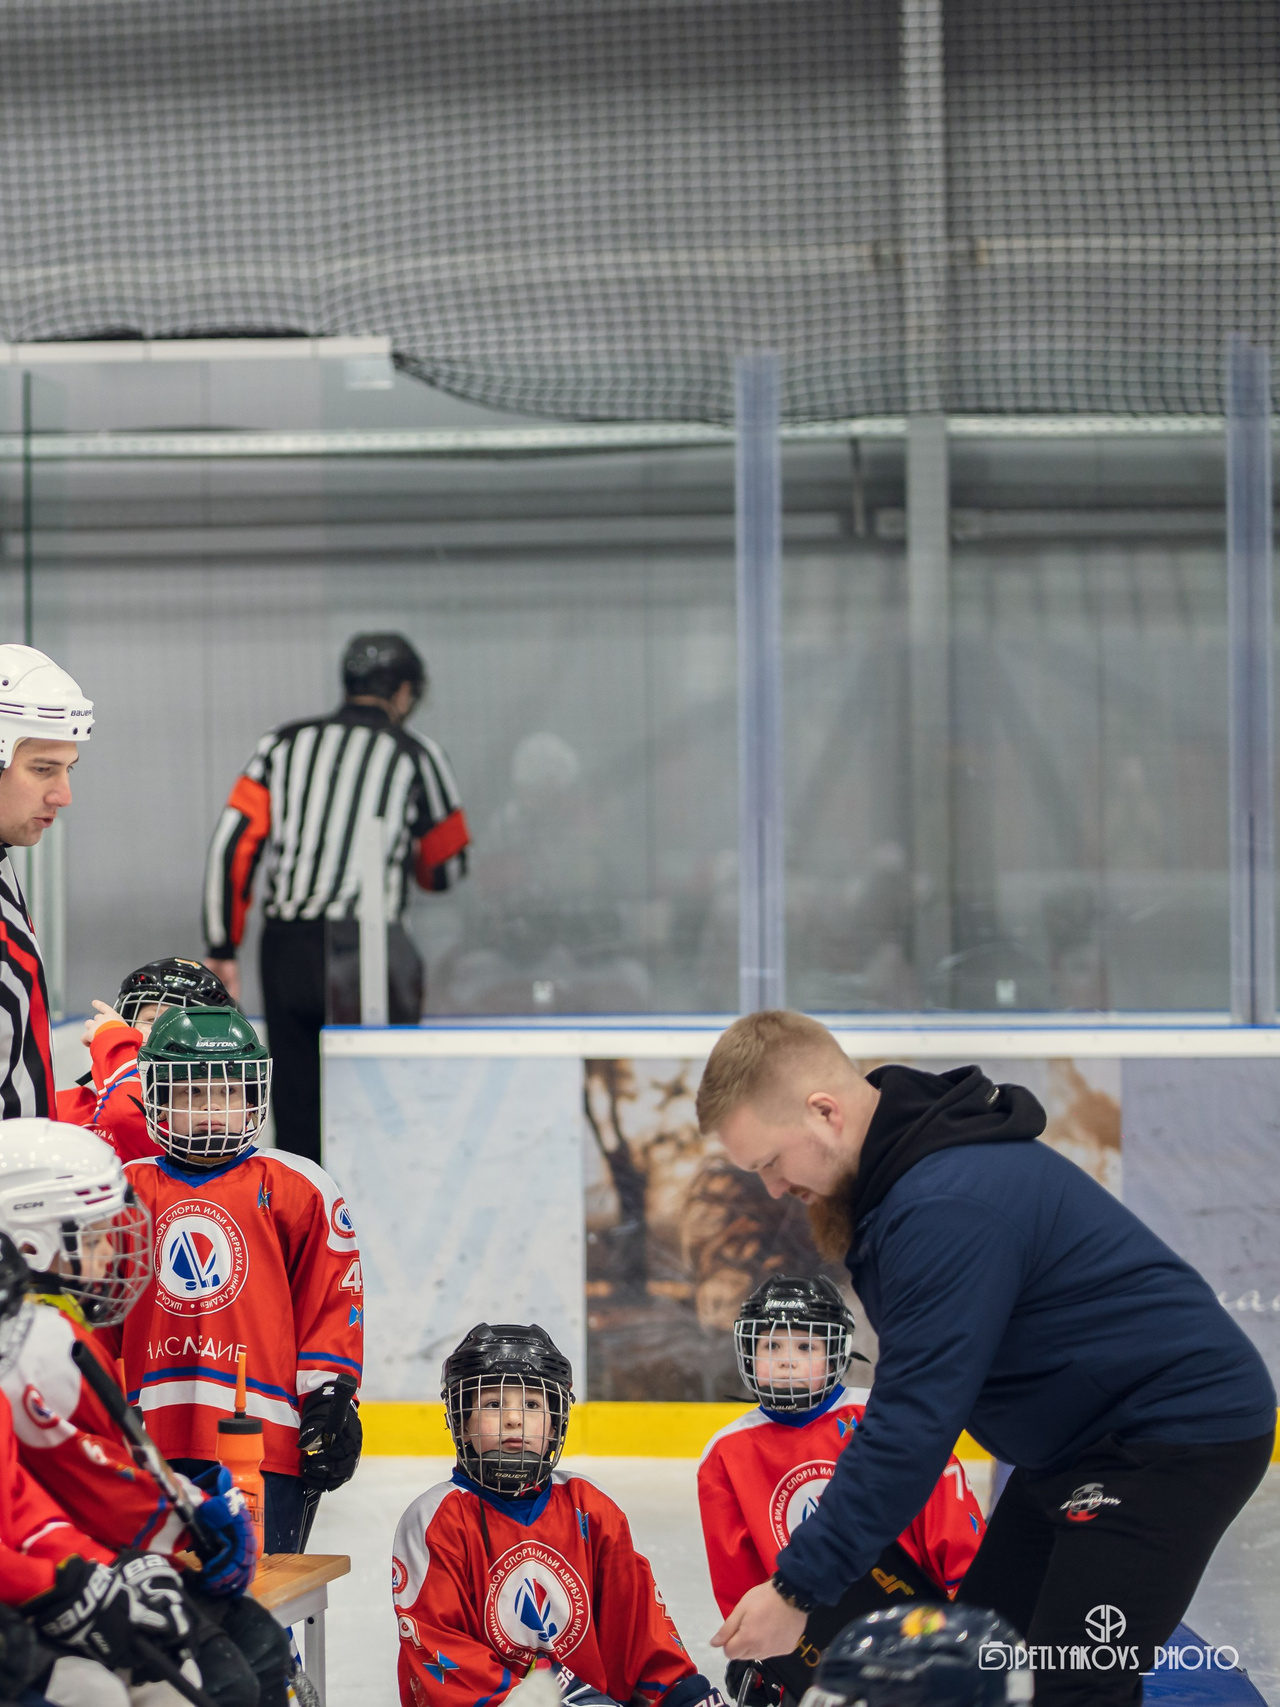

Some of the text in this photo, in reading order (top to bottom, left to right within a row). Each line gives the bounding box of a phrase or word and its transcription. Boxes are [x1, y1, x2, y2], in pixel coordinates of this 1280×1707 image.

[163, 975, 197, 987] CCM
[13, 1201, 44, 1210] CCM
[165, 1205, 200, 1223] СПОРТА
[203, 1206, 227, 1225] ИЛЬИ
[225, 1226, 244, 1272] АВЕРБУХА
[786, 1468, 817, 1490] СПОРТА
[558, 1568, 584, 1616] АВЕРБУХА
